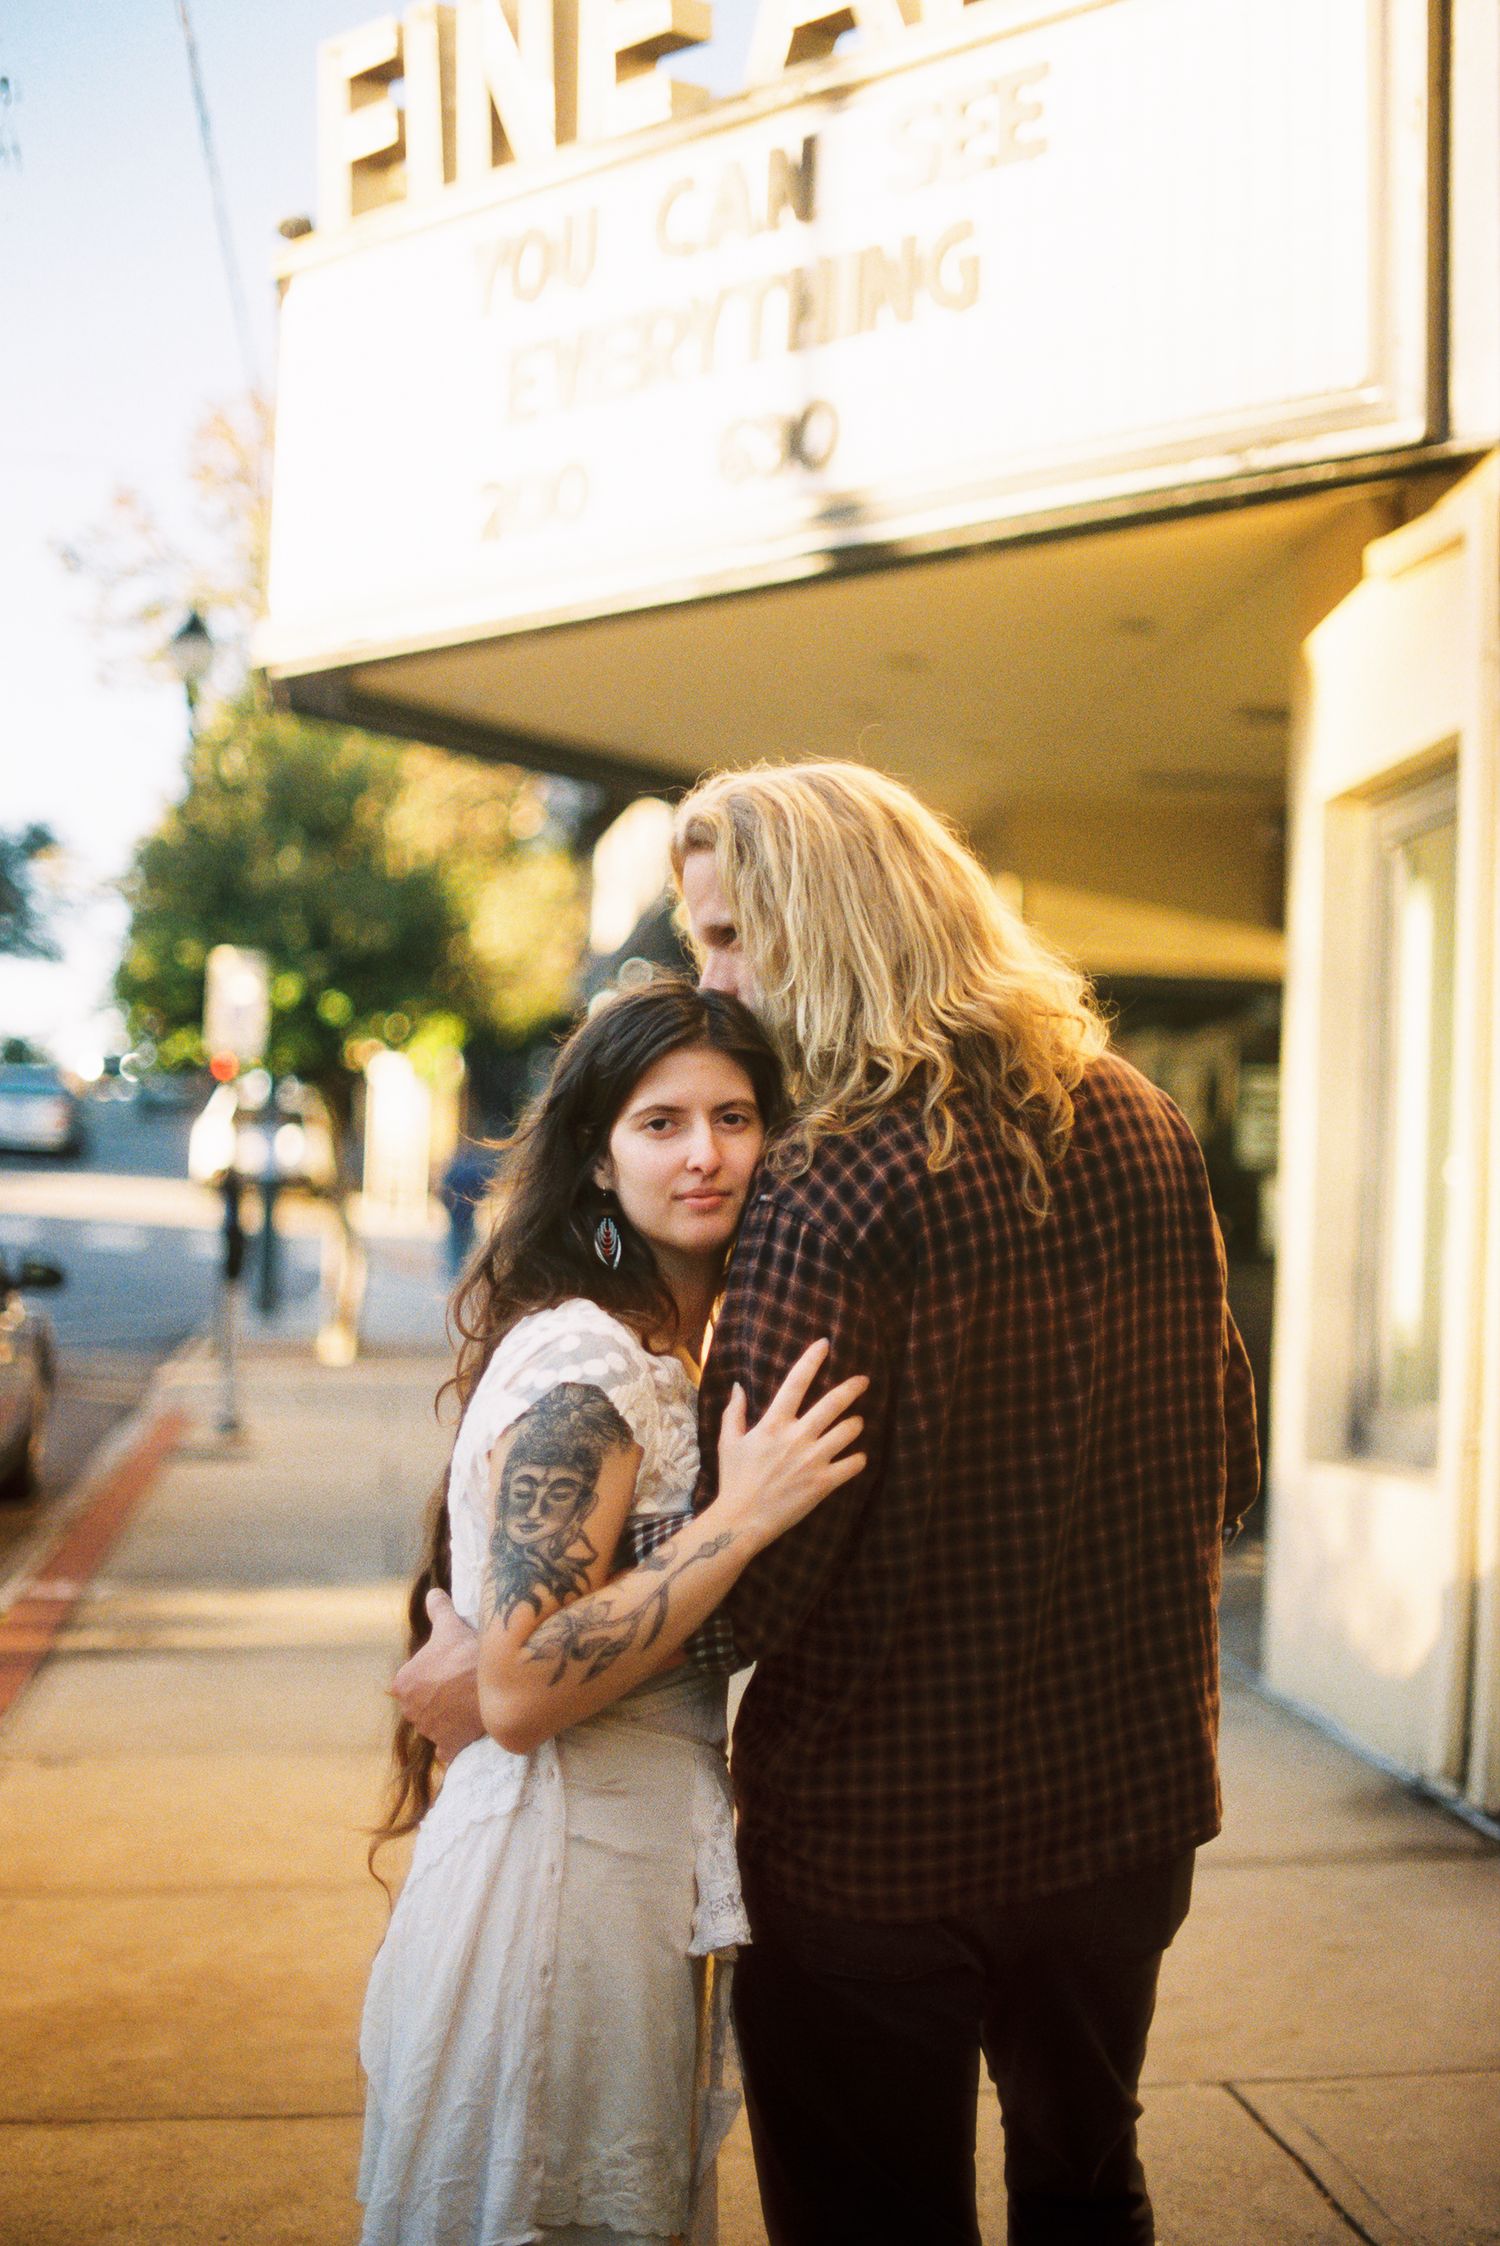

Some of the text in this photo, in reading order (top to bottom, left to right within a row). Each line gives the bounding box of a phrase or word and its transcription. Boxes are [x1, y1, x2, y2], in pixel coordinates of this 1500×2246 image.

[318, 0, 710, 228] FINE
[474, 60, 1053, 318] YOU CAN SEE
[503, 216, 984, 427] EVERYTHING
